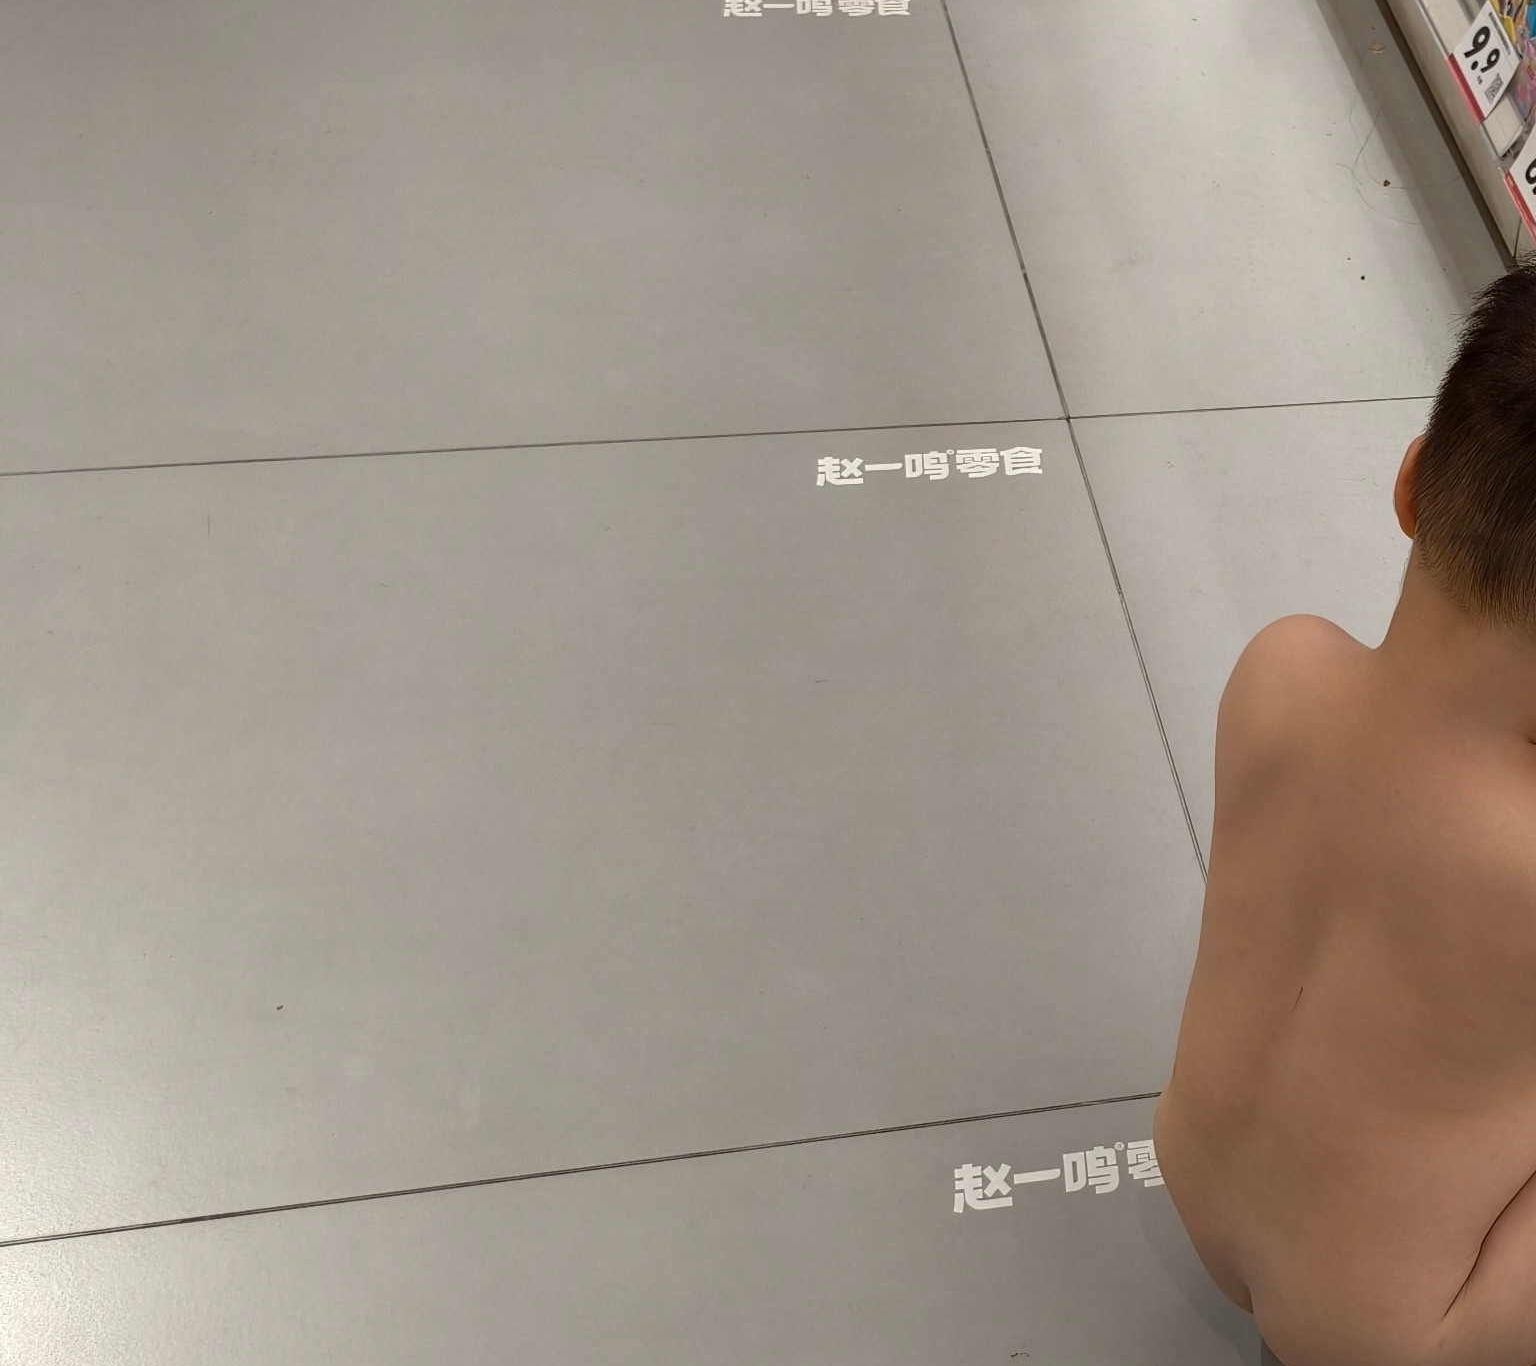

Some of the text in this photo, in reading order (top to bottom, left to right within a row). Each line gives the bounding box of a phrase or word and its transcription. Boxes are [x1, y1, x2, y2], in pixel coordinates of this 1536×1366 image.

[1464, 26, 1500, 73] 9.9
[816, 446, 1042, 487] 赵一鸣零食
